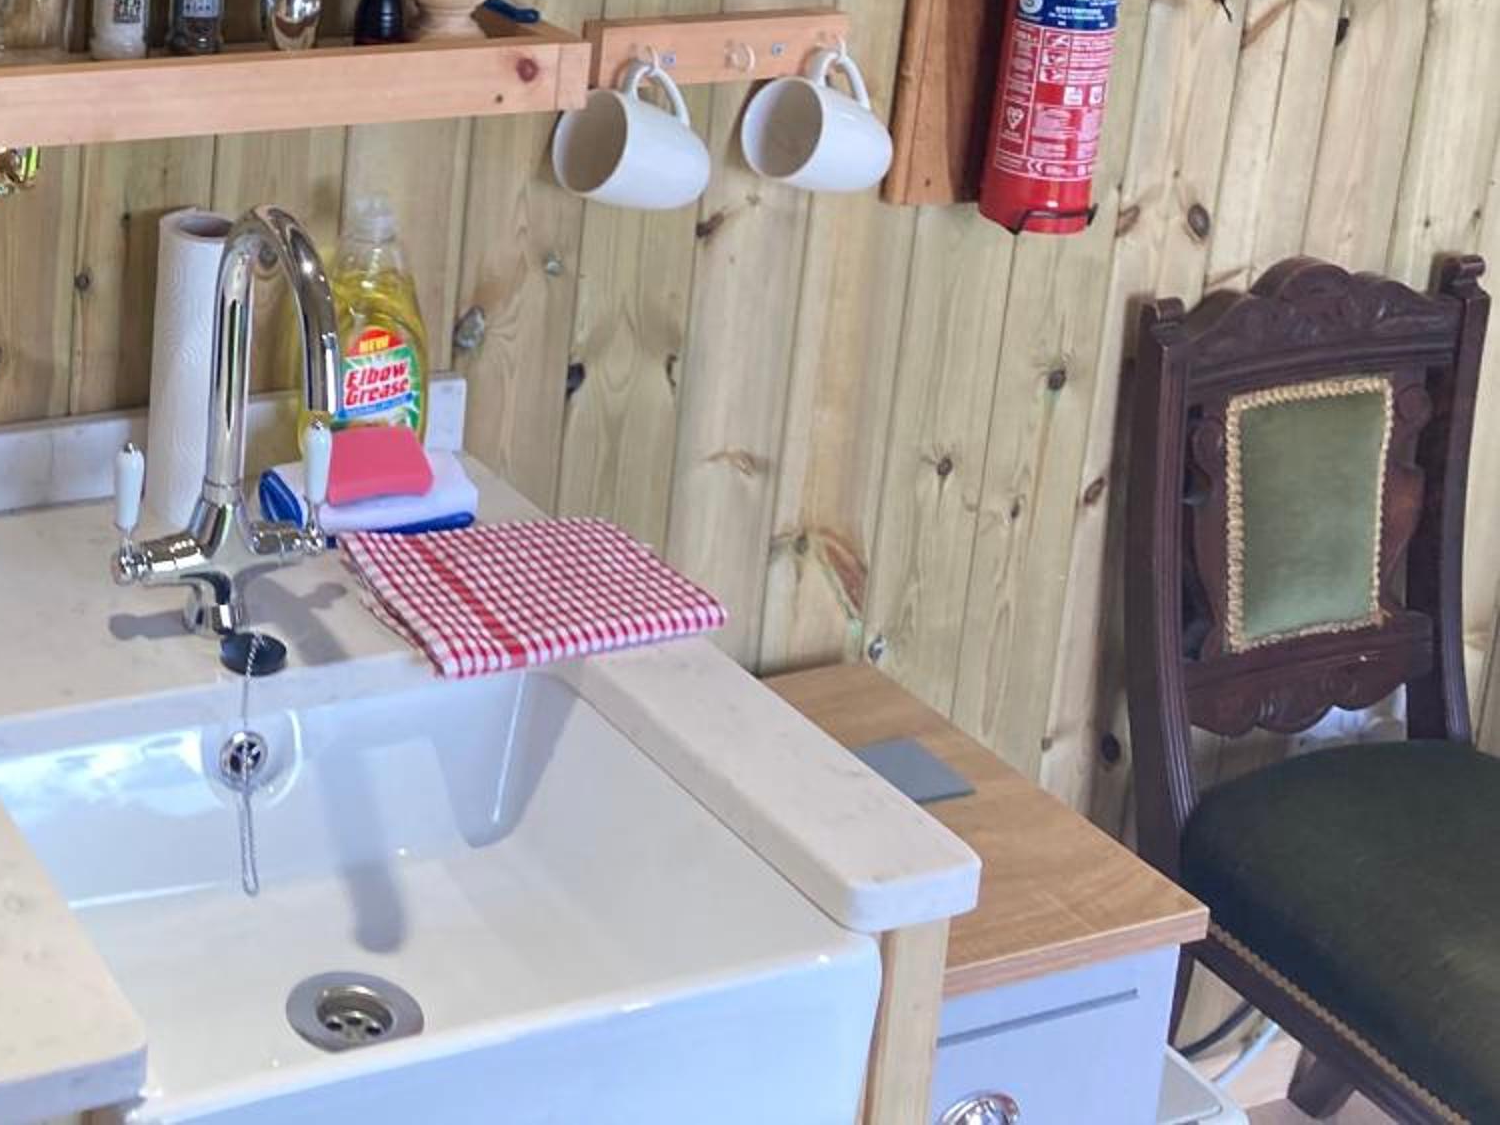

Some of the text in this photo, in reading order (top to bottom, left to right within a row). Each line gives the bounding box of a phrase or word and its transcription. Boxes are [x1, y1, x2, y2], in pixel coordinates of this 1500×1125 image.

[360, 334, 389, 354] NEW
[346, 361, 408, 389] Elbow
[346, 378, 410, 407] Grease
